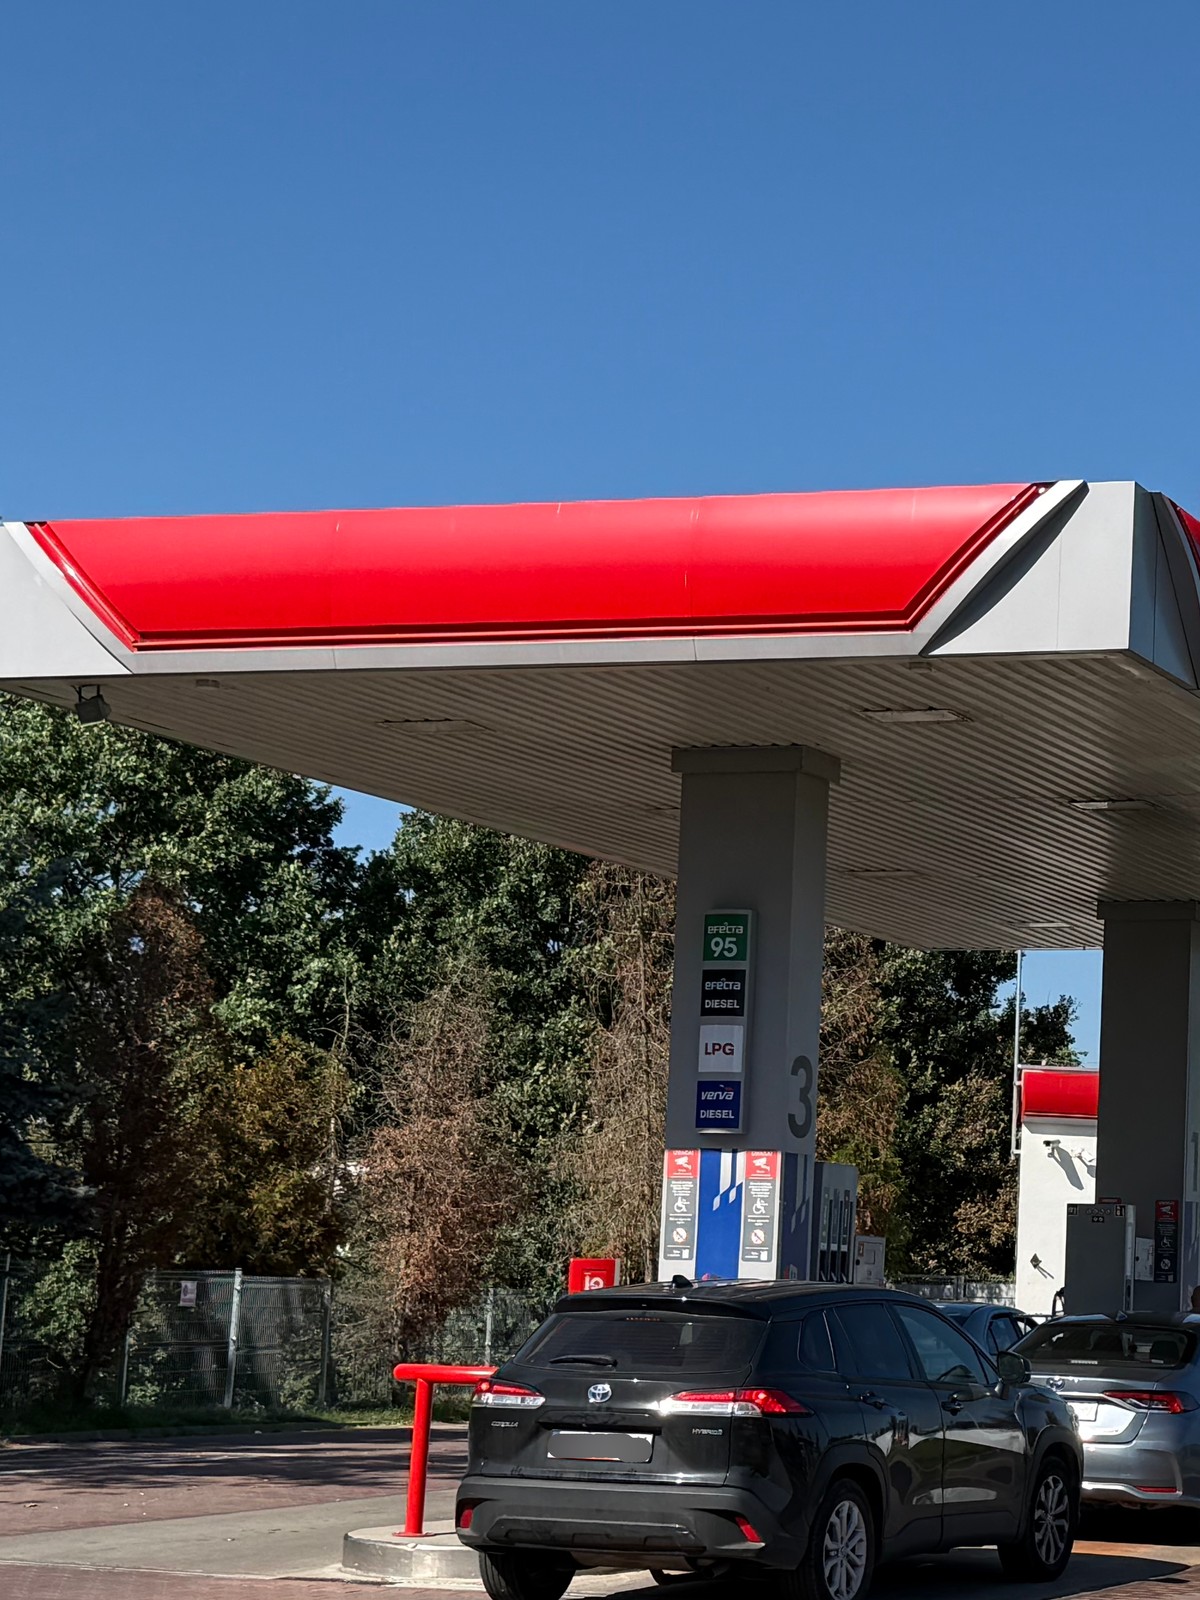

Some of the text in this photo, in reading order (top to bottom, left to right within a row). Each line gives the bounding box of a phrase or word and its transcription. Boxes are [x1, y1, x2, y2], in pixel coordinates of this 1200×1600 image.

[710, 936, 738, 958] 95
[704, 999, 740, 1009] DIESEL
[704, 1042, 735, 1056] LPG
[701, 1091, 735, 1101] verva
[787, 1055, 814, 1139] 3
[700, 1109, 735, 1119] DIESEL
